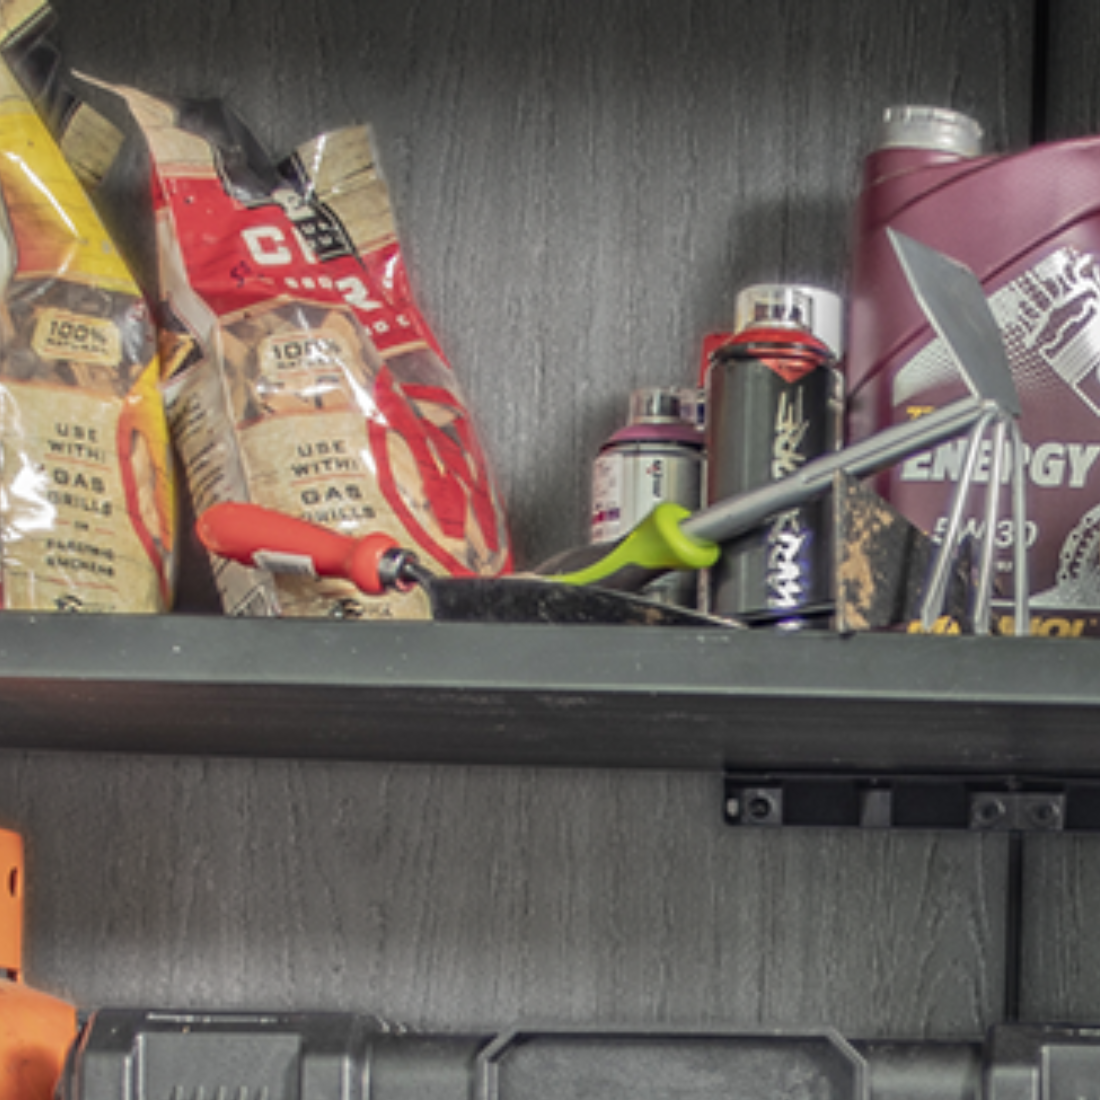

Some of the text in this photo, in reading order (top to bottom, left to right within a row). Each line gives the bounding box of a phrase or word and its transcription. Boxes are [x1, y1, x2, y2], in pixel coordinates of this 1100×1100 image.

[51, 320, 108, 344] 100%
[55, 422, 98, 443] USE
[297, 439, 346, 458] USE
[52, 467, 106, 495] GAS
[300, 483, 363, 506] GAS
